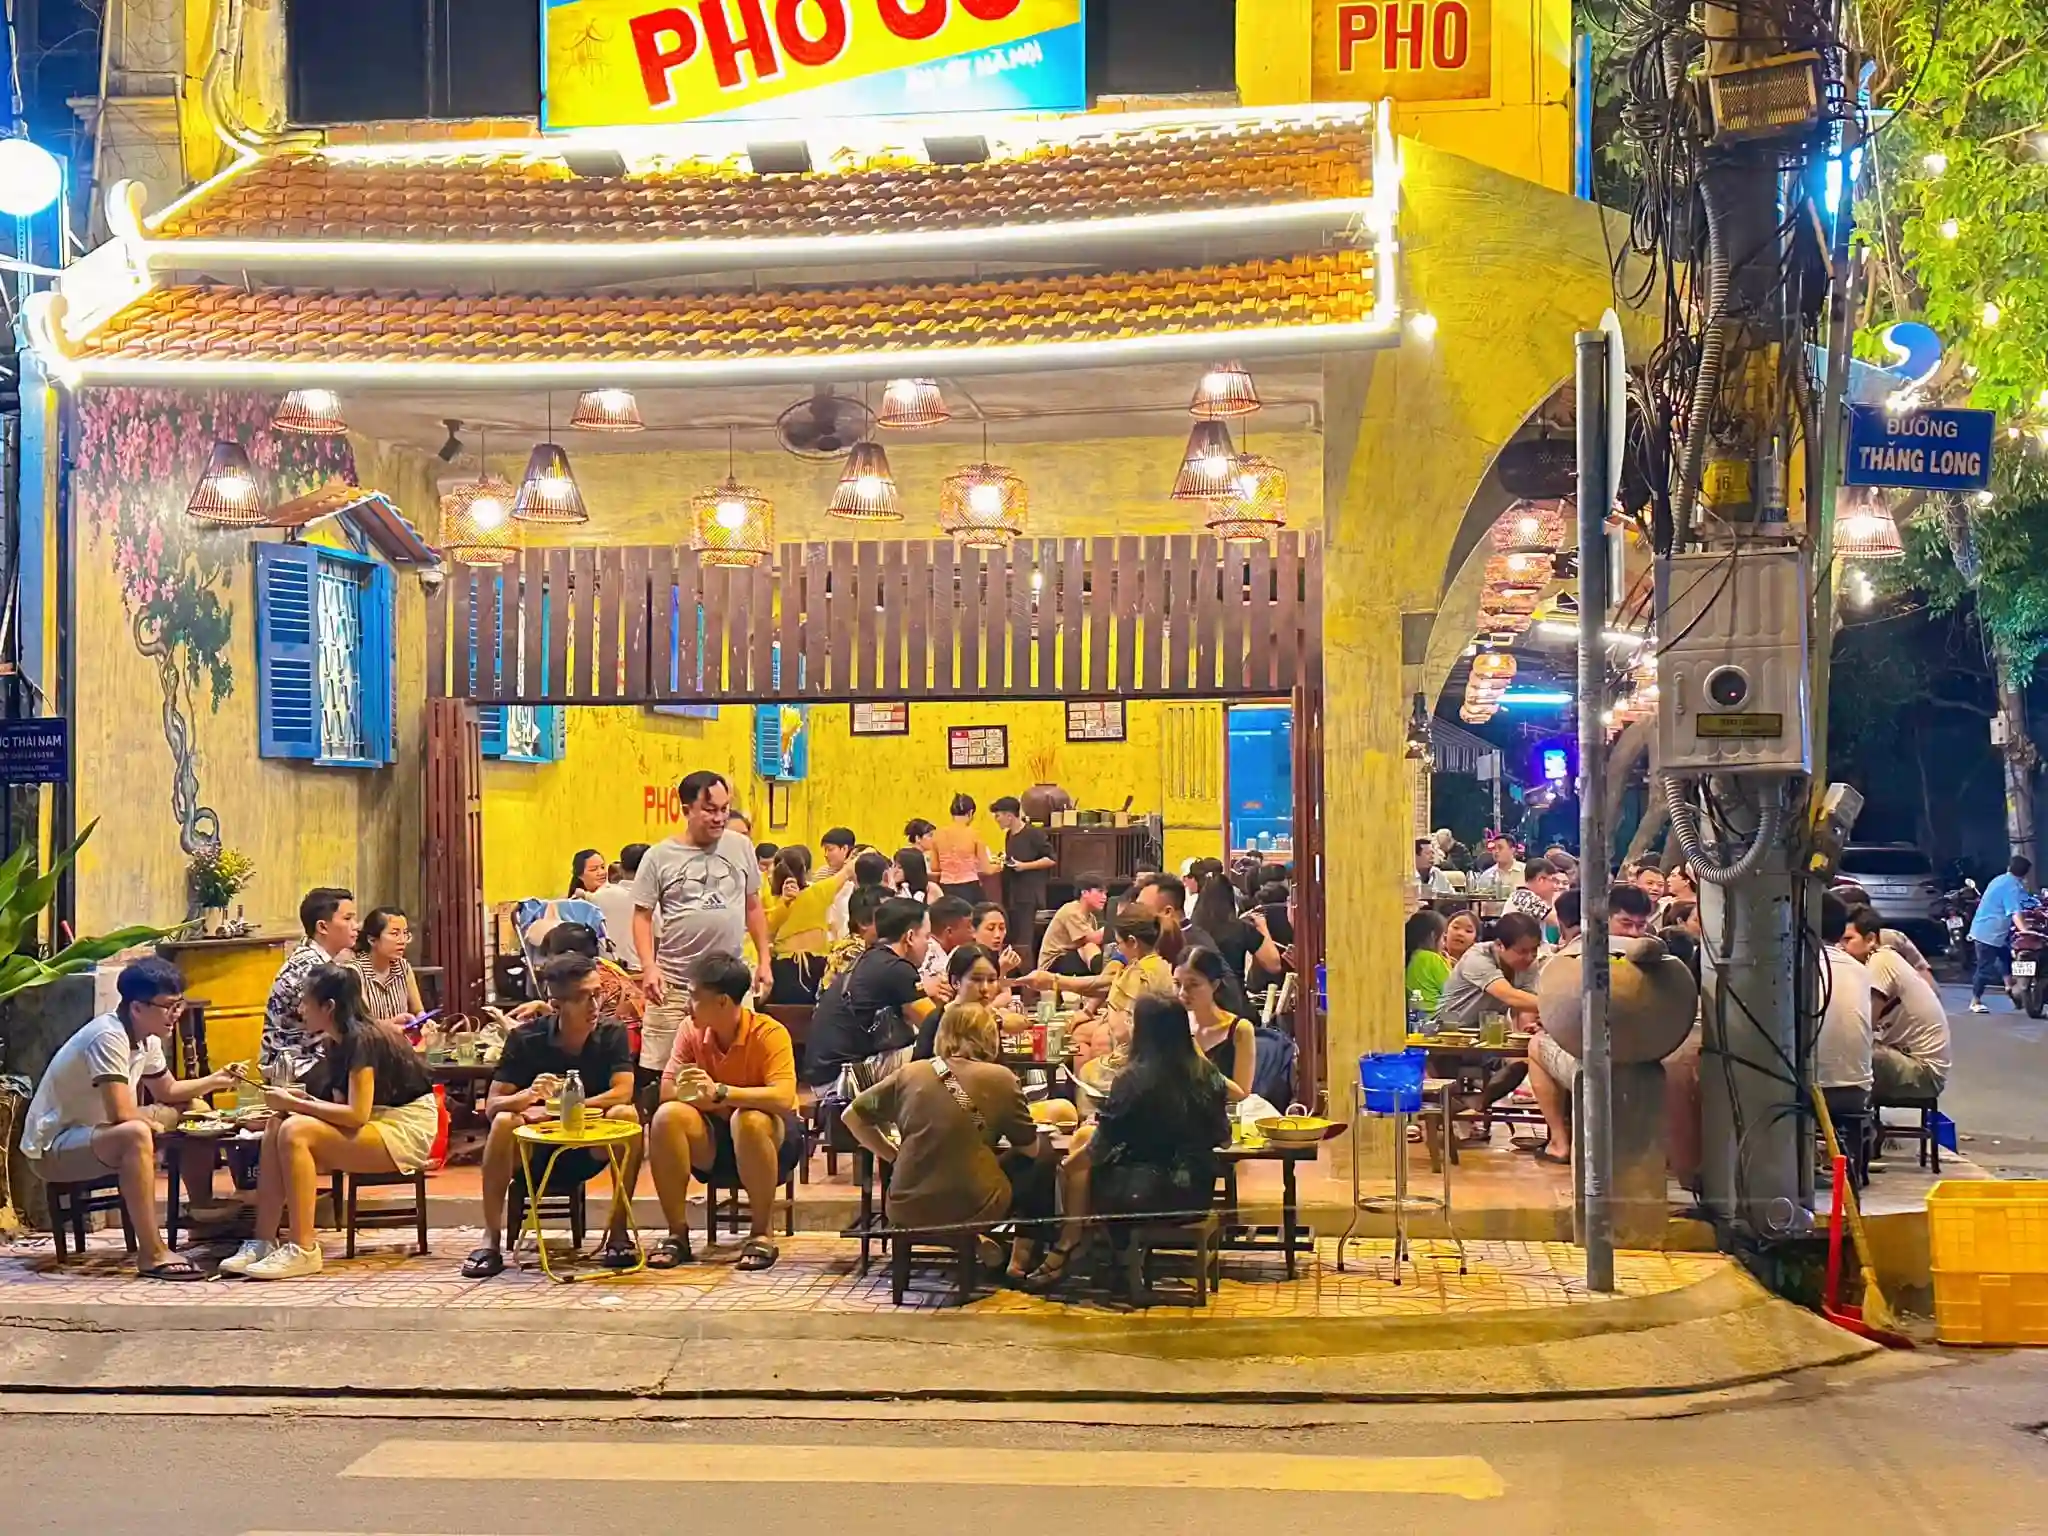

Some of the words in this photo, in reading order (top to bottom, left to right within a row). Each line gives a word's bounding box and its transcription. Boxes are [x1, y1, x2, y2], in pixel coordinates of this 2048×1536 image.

[1887, 416, 1958, 438] ĐƯỜNG
[1858, 440, 1924, 473] THĂNG
[1929, 450, 1981, 476] LONG
[38, 735, 62, 747] NAM
